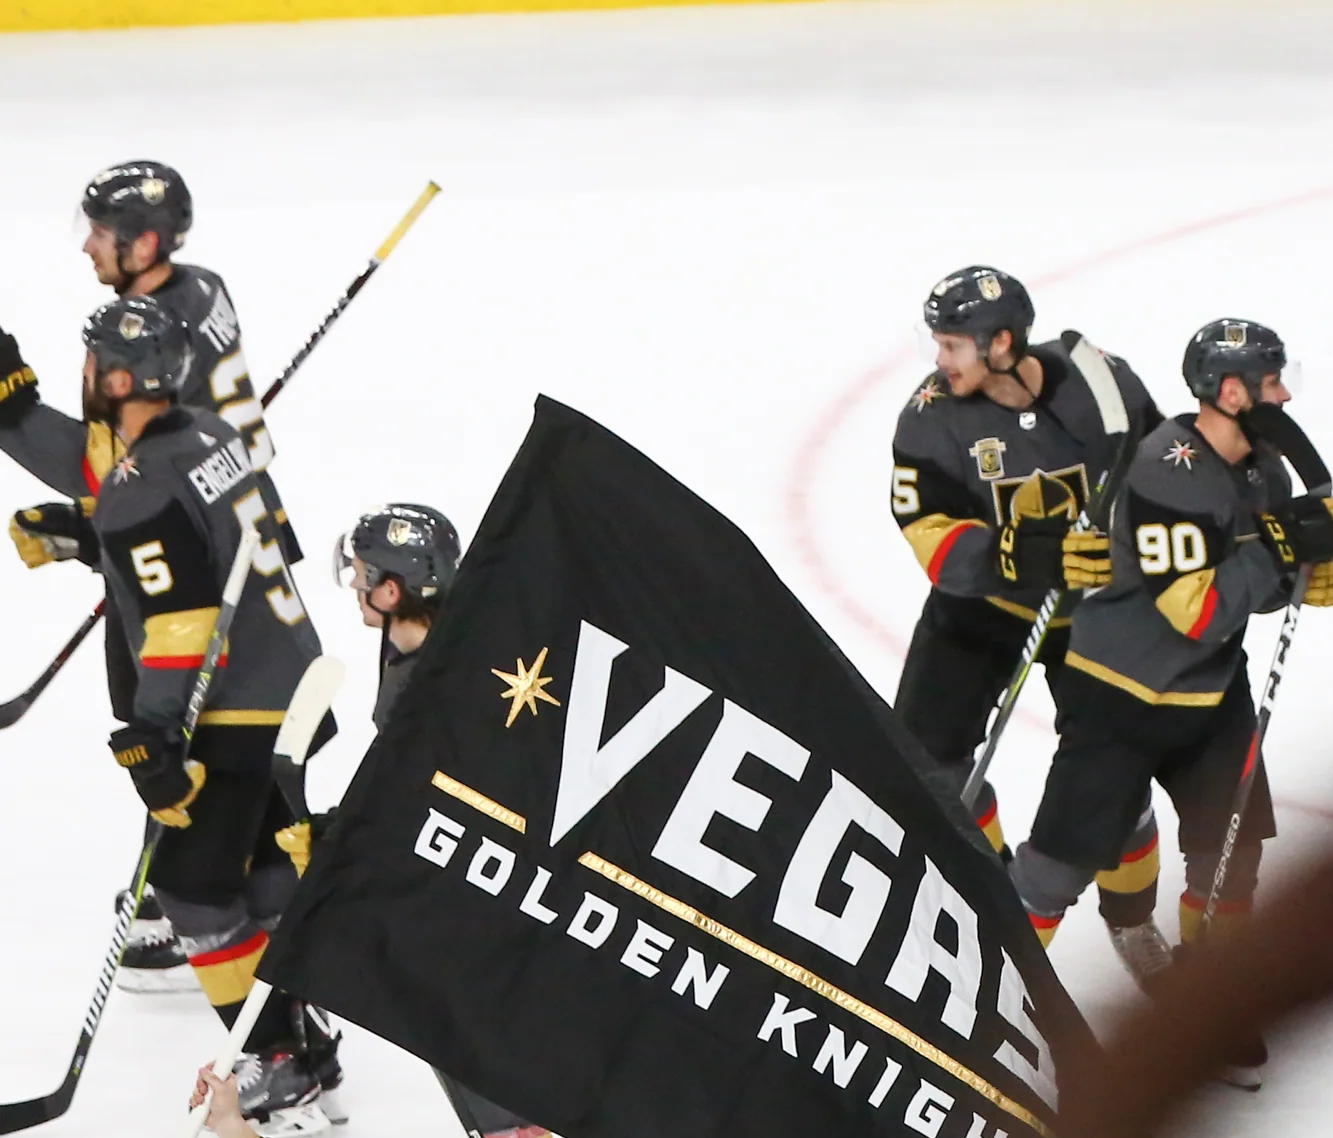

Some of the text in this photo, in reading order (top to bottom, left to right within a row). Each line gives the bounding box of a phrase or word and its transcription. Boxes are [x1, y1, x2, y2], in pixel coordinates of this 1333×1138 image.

[892, 466, 920, 515] 5
[130, 540, 173, 596] 5
[1136, 522, 1207, 574] 90
[550, 620, 1060, 1113] VEGAS
[414, 807, 730, 1010] GOLDEN
